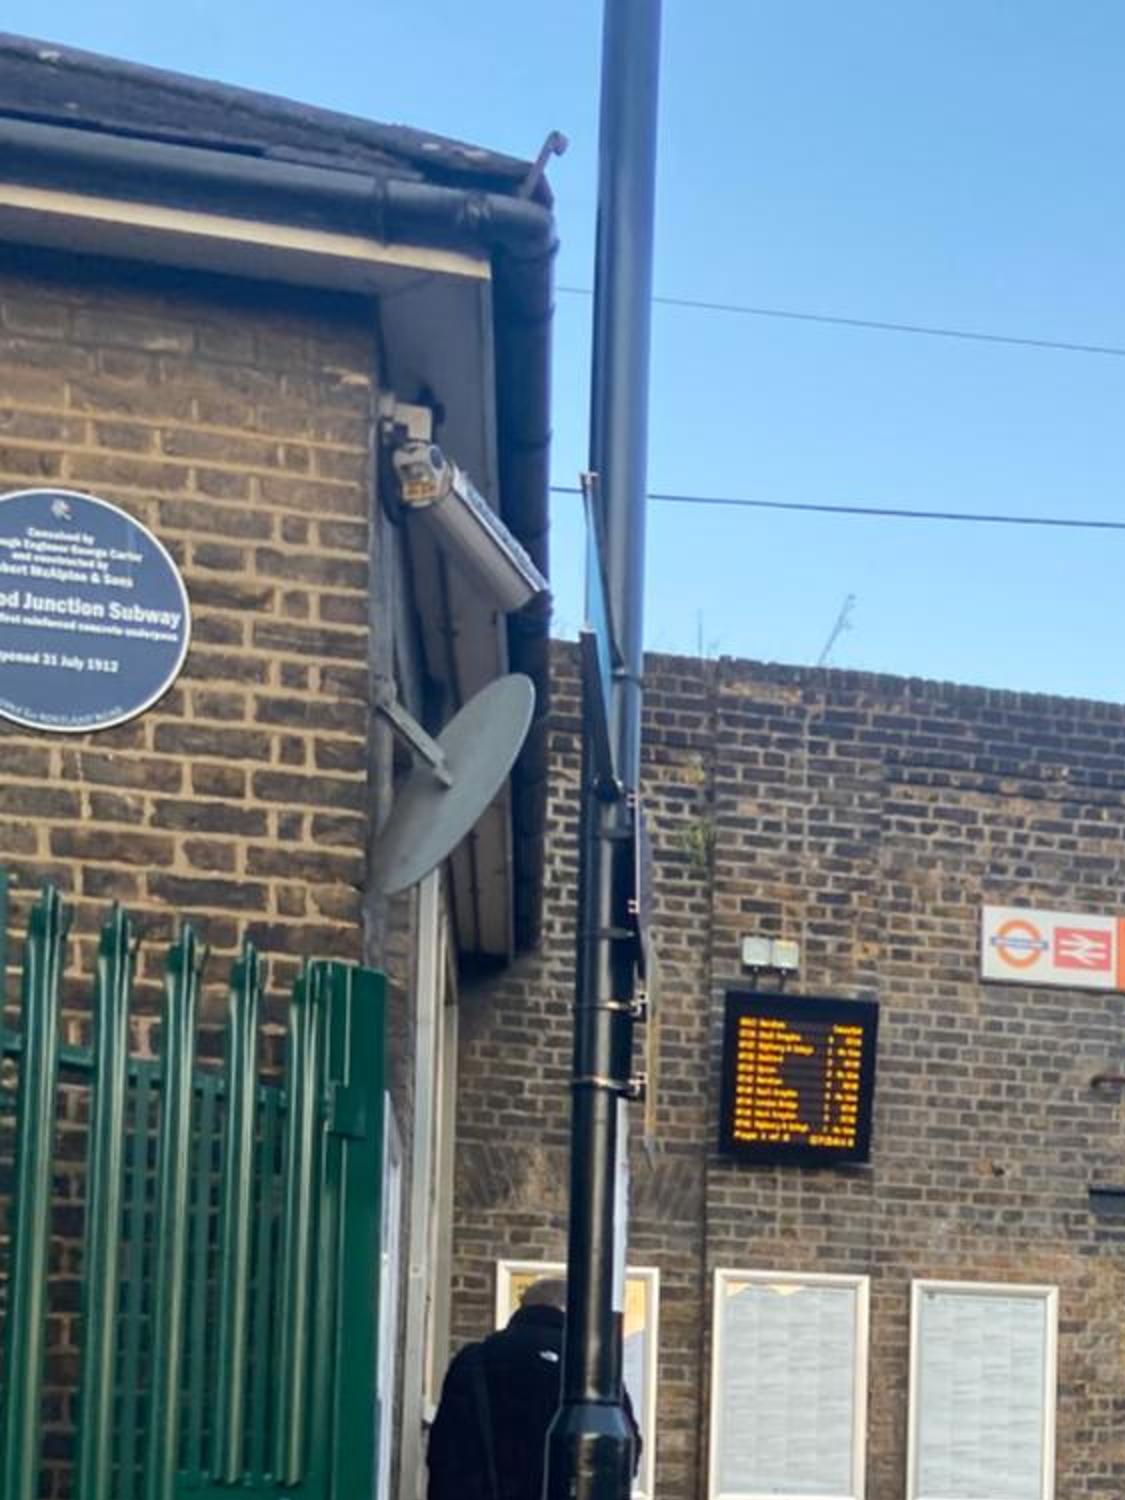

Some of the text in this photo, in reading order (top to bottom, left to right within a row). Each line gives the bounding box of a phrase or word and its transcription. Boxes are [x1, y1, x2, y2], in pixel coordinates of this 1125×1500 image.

[91, 571, 100, 584] &
[23, 592, 105, 618] Junction
[109, 601, 181, 630] Subway
[61, 654, 84, 673] July
